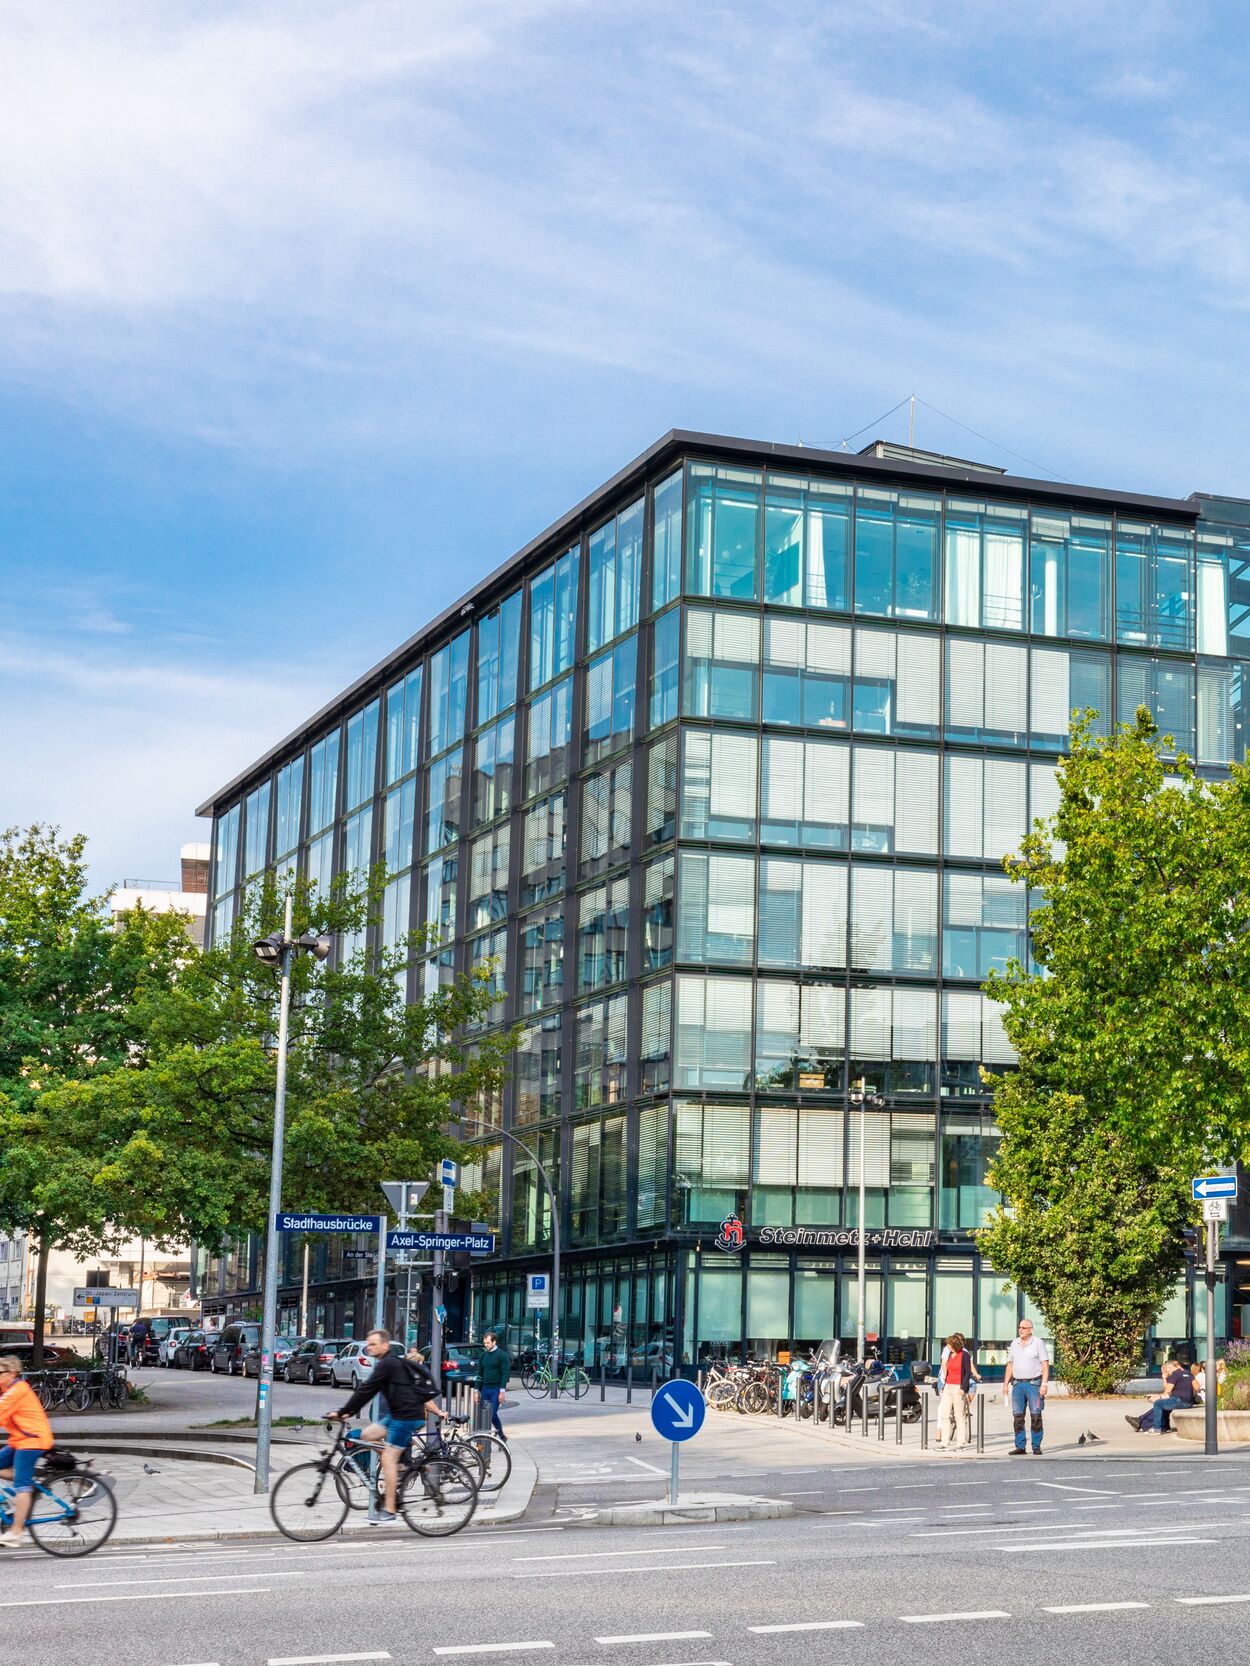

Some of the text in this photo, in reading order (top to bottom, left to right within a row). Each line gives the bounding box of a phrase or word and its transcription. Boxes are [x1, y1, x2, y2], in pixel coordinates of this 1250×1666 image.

[283, 1217, 373, 1231] Stadthausbrücke
[391, 1234, 490, 1250] Axel-Springer-Platz
[759, 1227, 933, 1247] Steinmetz + Hehl
